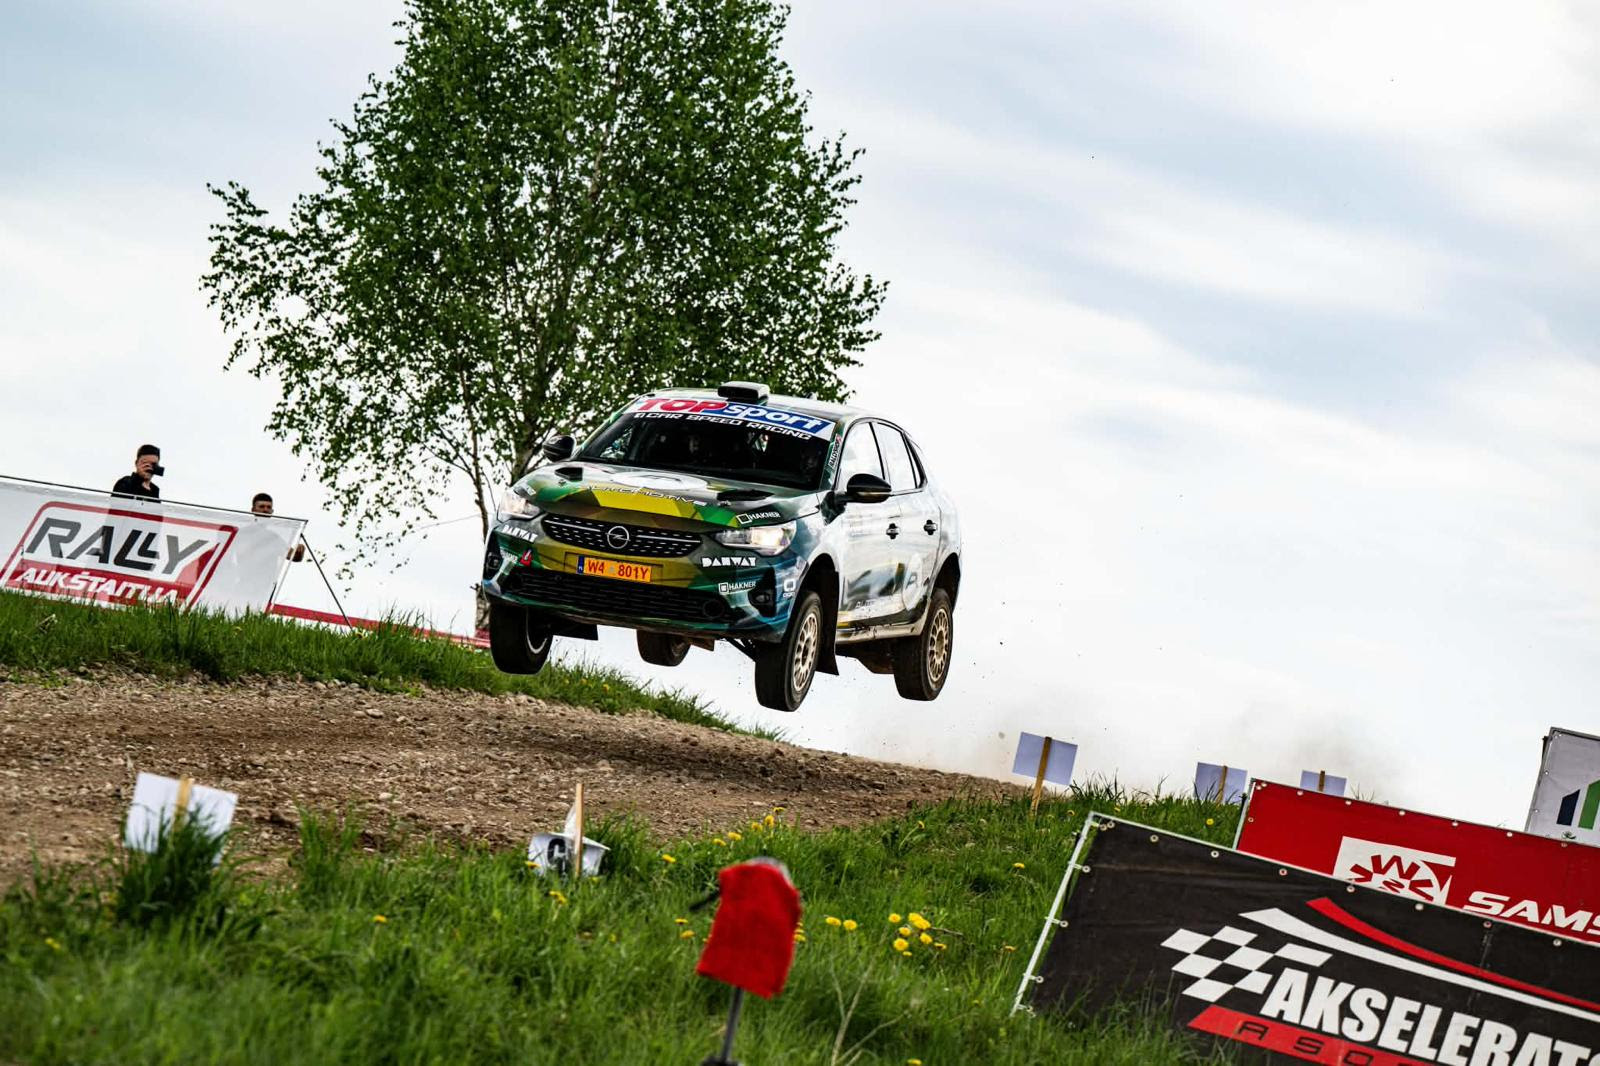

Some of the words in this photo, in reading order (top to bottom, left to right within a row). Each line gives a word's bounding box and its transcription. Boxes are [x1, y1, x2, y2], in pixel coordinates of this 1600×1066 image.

[686, 414, 742, 426] SPEED
[746, 421, 813, 441] RACING
[25, 517, 209, 575] RALLY
[587, 559, 605, 575] W4
[617, 564, 649, 580] 801Y
[728, 580, 757, 591] HAKNER
[1260, 967, 1600, 1066] AKSELERAT
